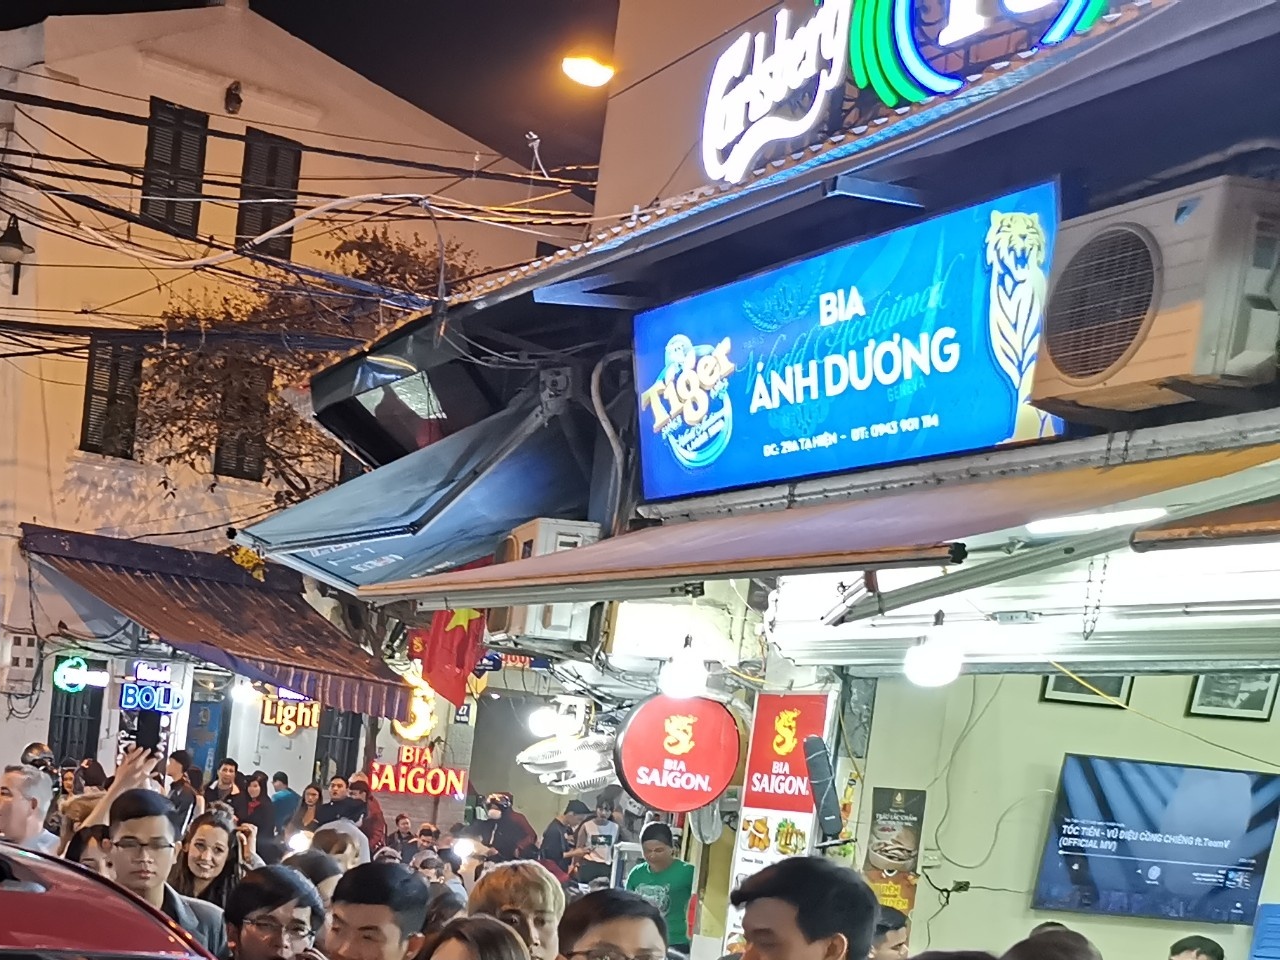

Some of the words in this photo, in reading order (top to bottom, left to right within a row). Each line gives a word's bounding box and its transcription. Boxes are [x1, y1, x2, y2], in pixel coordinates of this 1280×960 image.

[820, 285, 866, 327] BIA
[641, 337, 735, 433] Tiger
[749, 361, 819, 414] ÁNH
[824, 326, 961, 397] DƯƠNG
[121, 684, 184, 713] BOLD
[262, 700, 320, 735] Light
[401, 747, 433, 764] BIA
[663, 758, 687, 772] BIA
[771, 761, 790, 775] BIA
